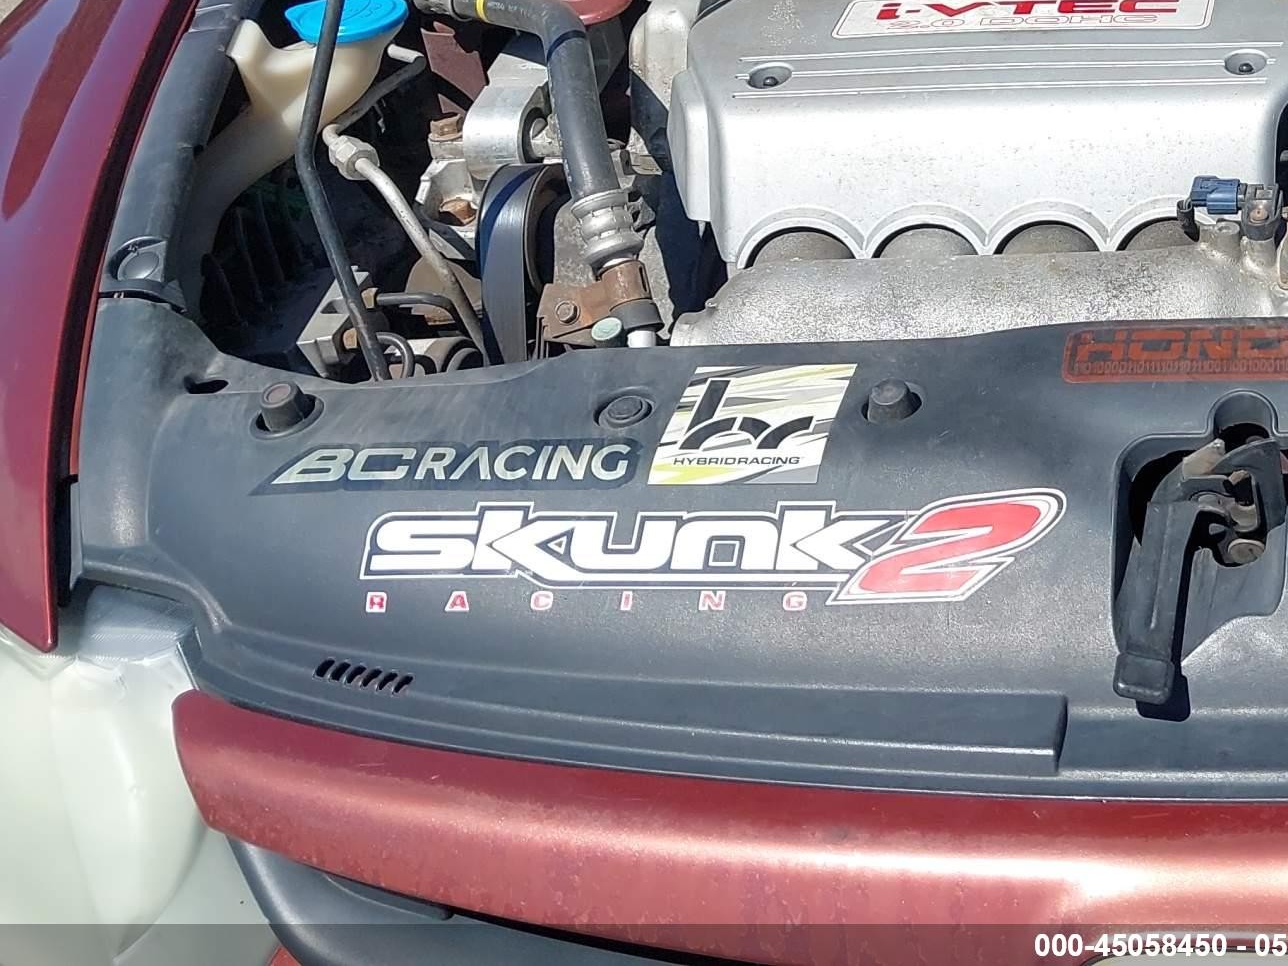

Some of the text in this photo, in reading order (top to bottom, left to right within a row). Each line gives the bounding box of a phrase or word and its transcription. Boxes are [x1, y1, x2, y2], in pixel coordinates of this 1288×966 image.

[886, 13, 1160, 31] 2.0 DOHC
[364, 590, 809, 614] RACING
